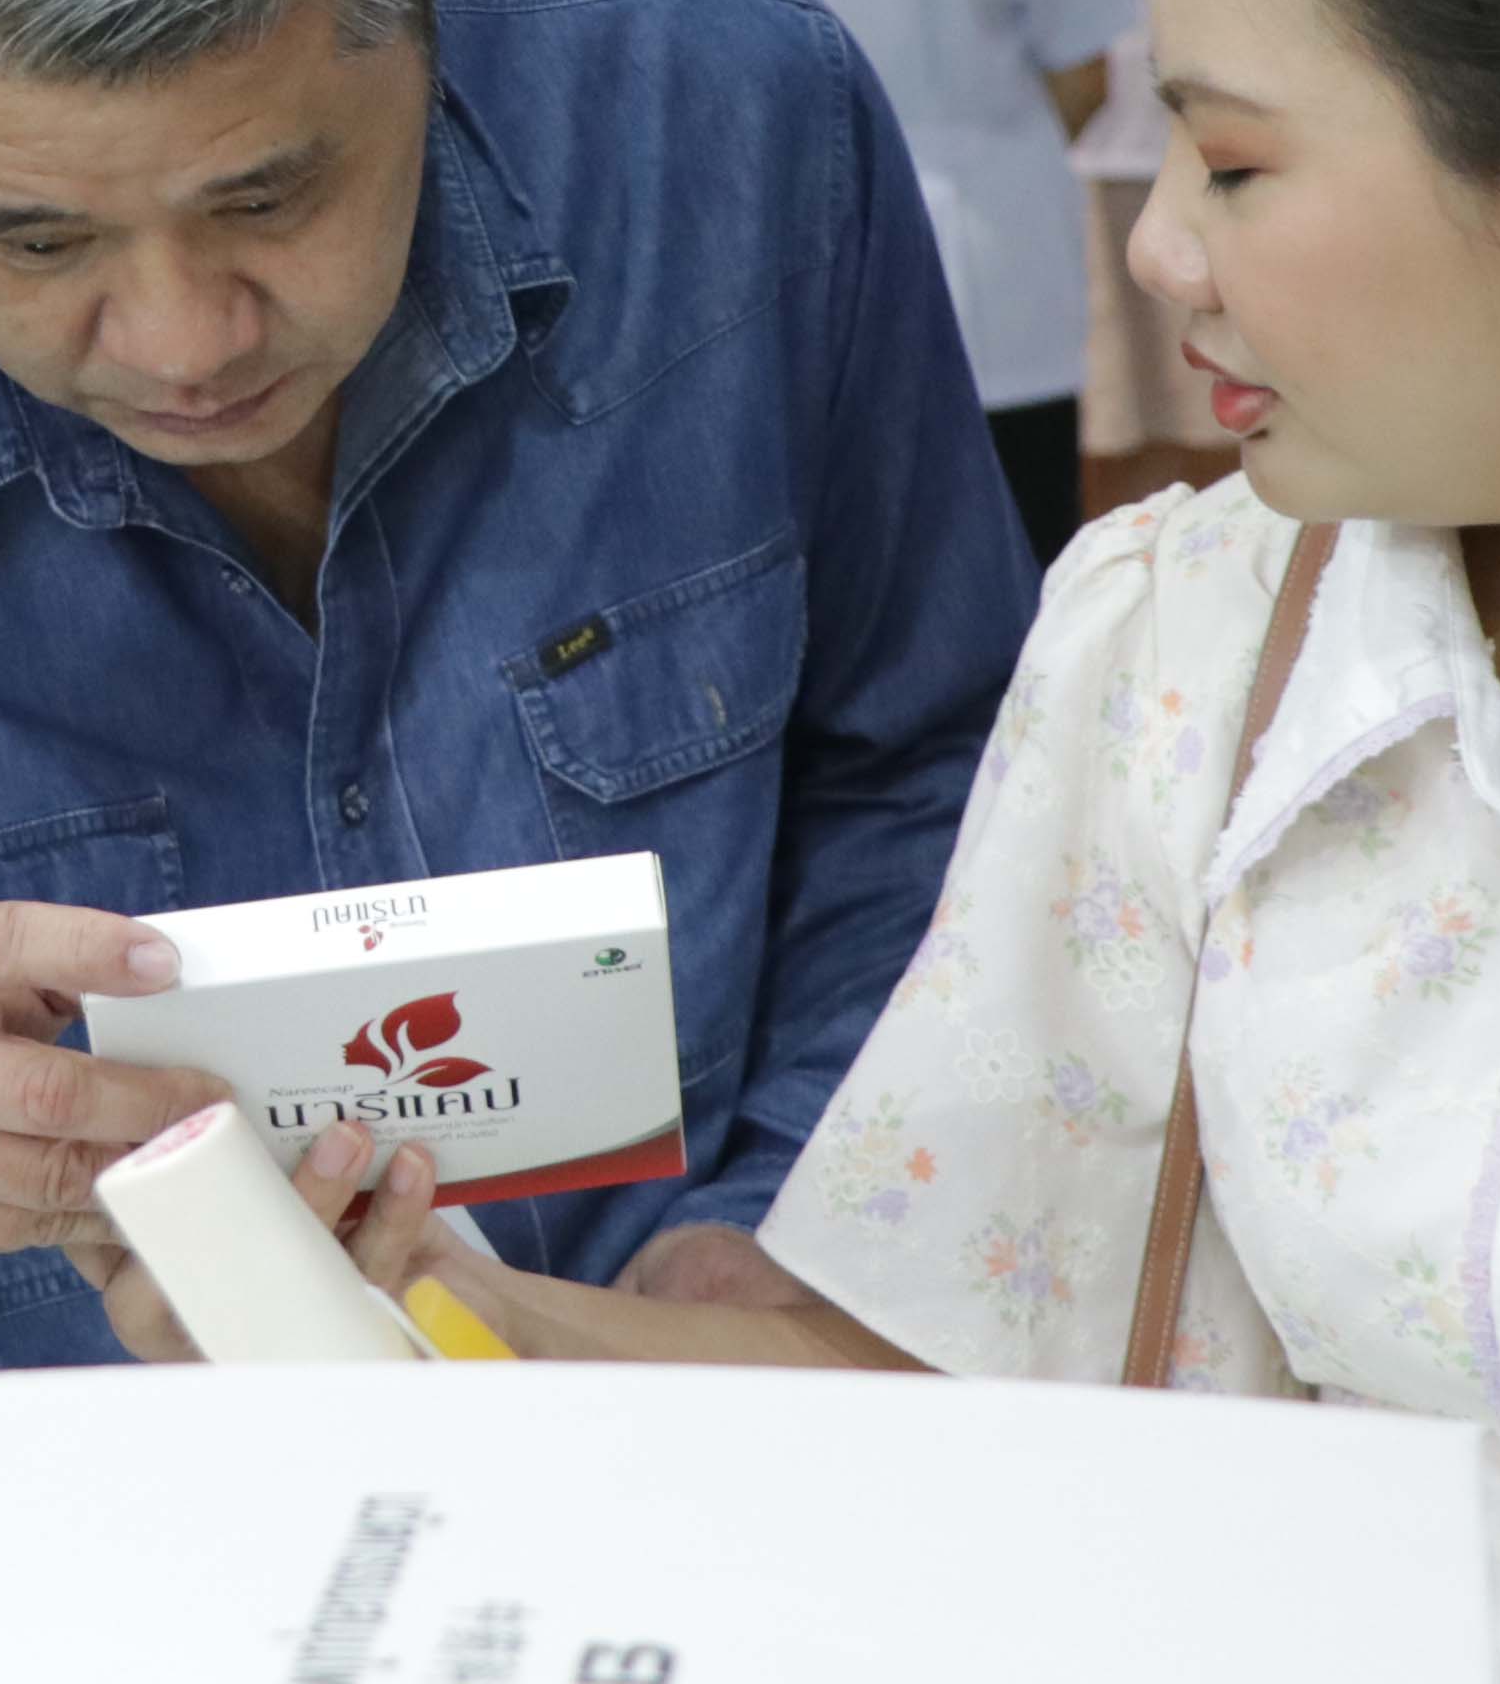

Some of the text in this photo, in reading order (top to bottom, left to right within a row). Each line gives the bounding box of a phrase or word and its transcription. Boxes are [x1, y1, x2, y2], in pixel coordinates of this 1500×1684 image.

[266, 1076, 521, 1129] นารีแคป
[267, 1083, 355, 1099] Nareecap
